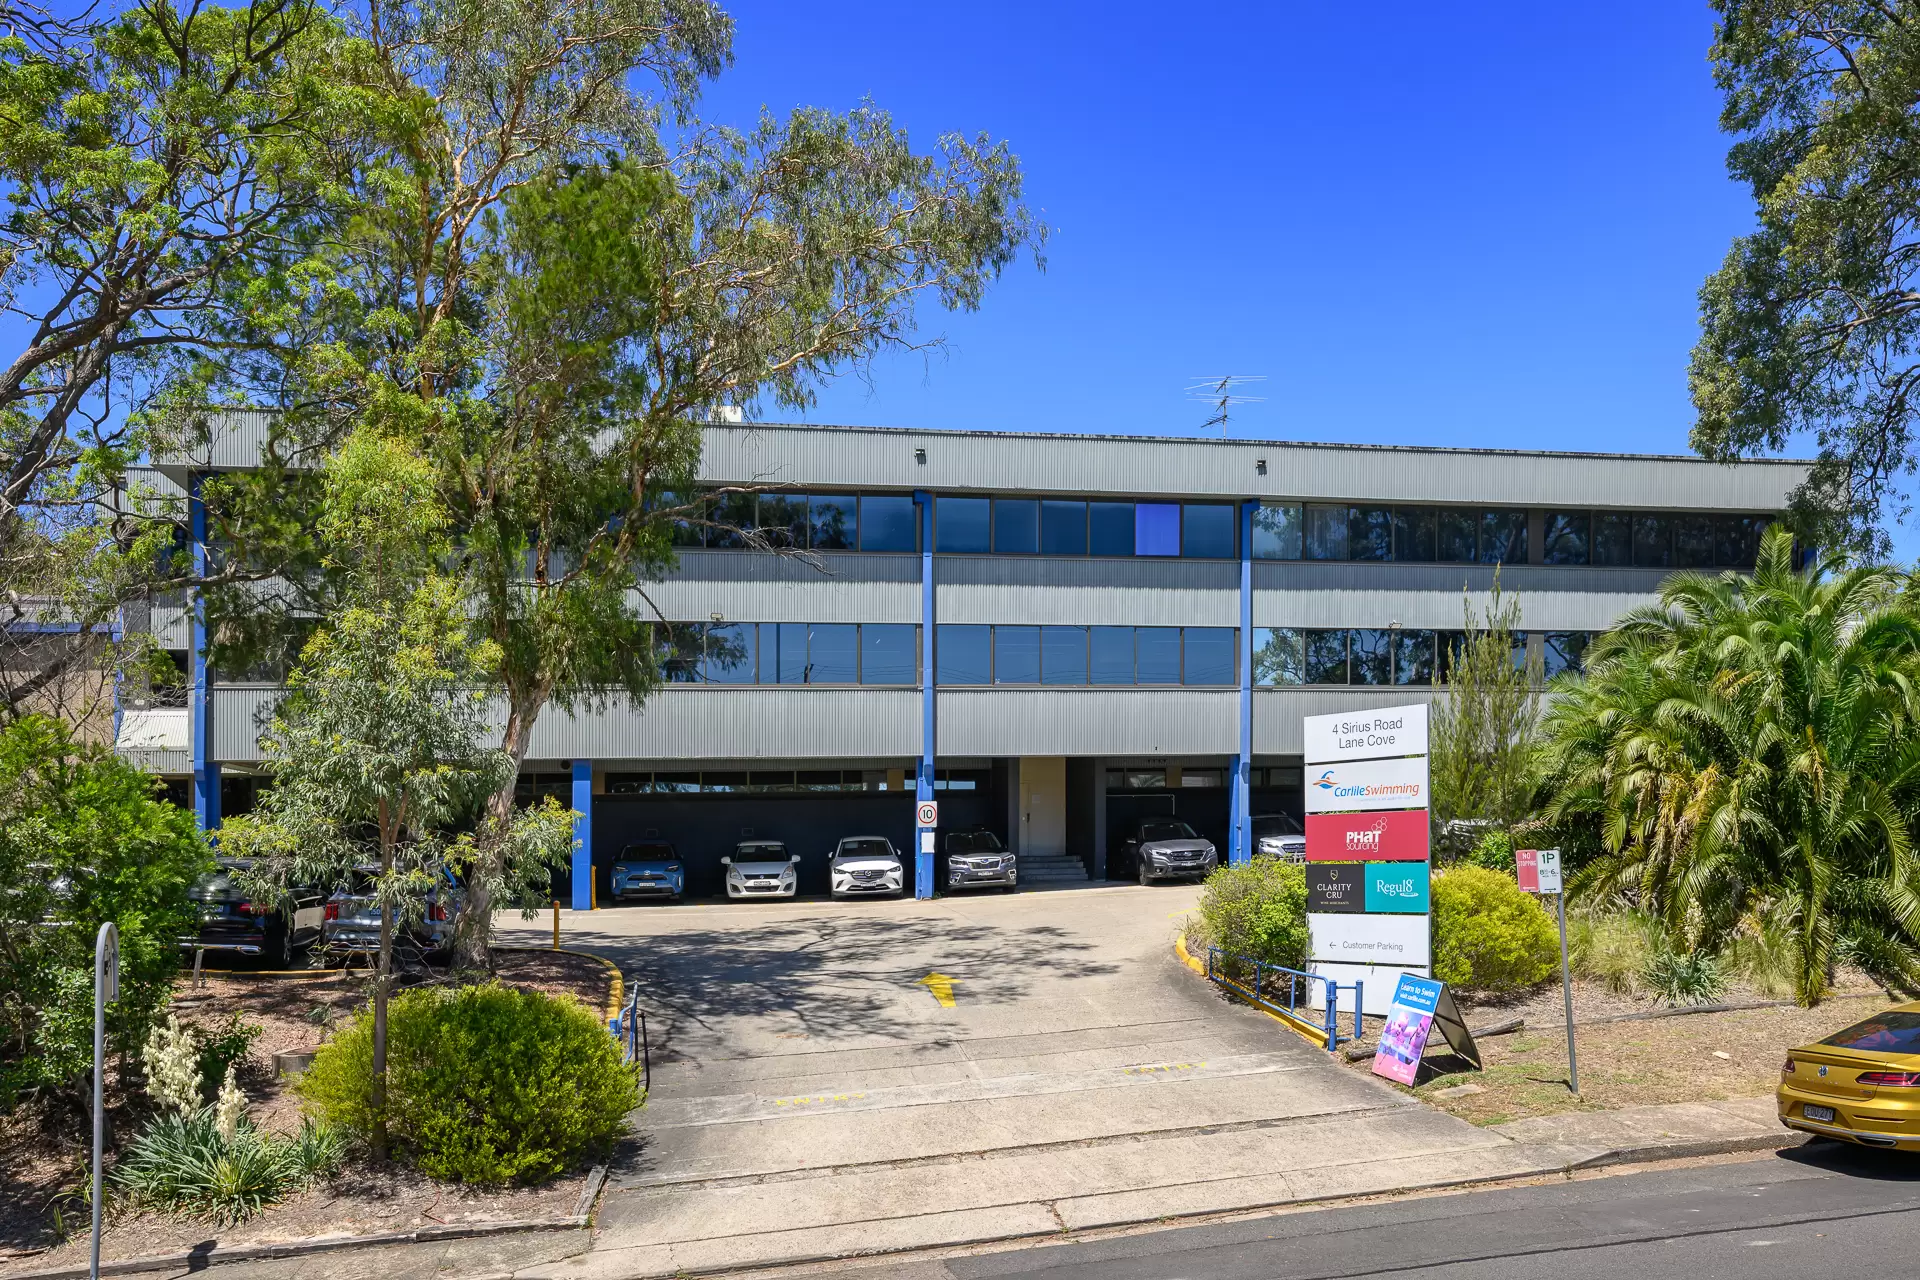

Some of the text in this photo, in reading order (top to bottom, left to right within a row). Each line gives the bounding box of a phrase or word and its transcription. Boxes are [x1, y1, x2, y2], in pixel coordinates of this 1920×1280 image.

[1332, 717, 1403, 735] 4 Sirius Road
[1339, 734, 1396, 749] Lane Cove
[922, 809, 933, 819] 10
[1346, 842, 1379, 853] sourcing
[1522, 852, 1531, 860] NO
[1541, 851, 1555, 864] 1P
[1316, 883, 1352, 891] CLARITY
[1325, 891, 1343, 899] CRU
[1342, 940, 1404, 952] Customer Parking
[1401, 982, 1436, 999] Learn to Swim
